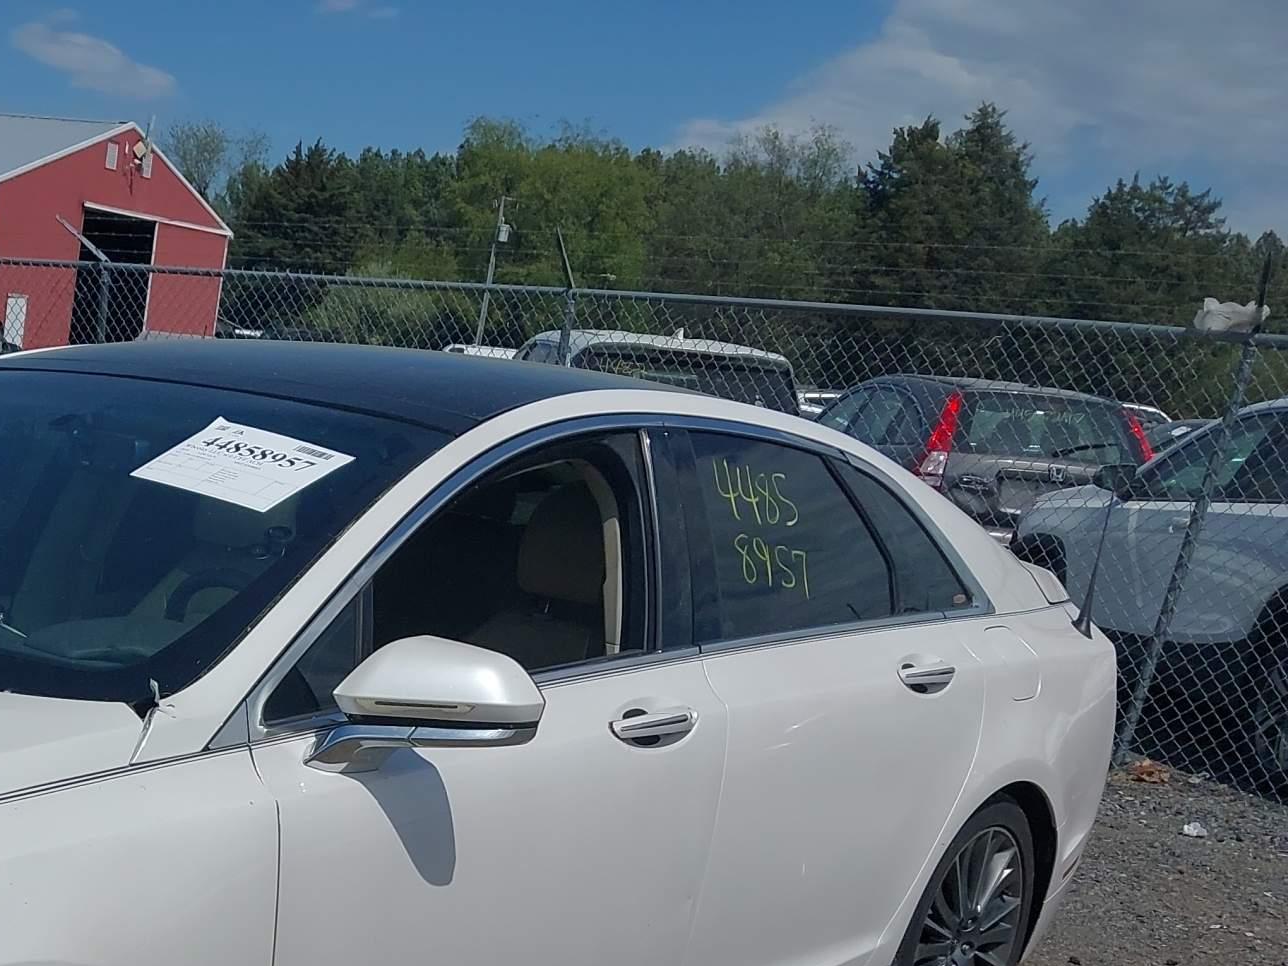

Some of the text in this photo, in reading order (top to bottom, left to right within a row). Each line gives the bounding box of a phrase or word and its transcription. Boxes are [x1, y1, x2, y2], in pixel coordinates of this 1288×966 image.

[202, 436, 317, 473] 44858957
[713, 458, 798, 526] 4485
[734, 533, 810, 600] 8957
